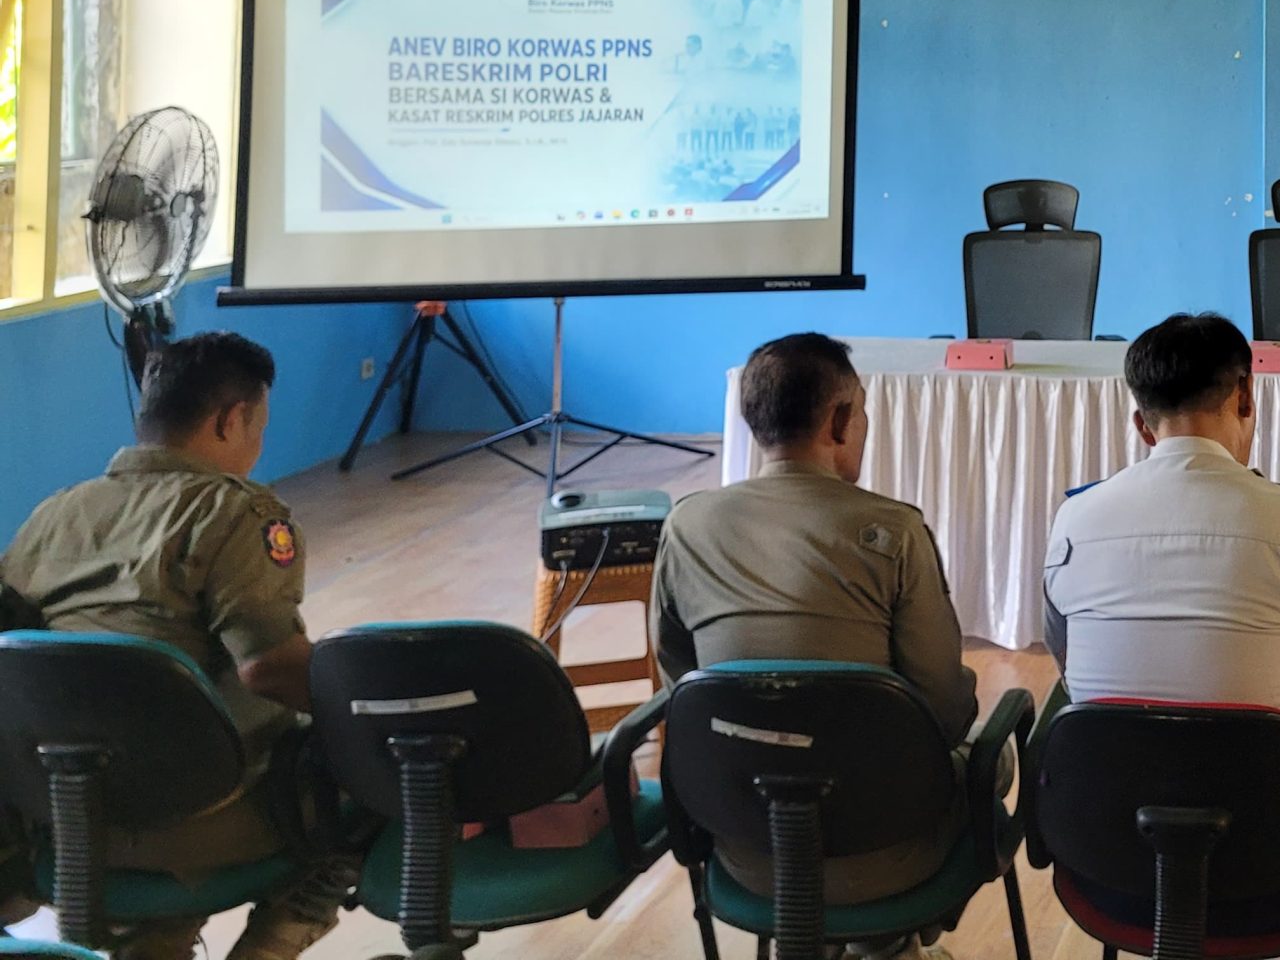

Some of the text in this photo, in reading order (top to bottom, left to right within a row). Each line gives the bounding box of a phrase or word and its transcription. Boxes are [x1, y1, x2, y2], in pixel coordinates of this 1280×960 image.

[388, 37, 652, 58] ANEV BIRO KORWAS PPNS
[388, 62, 608, 82] BARESKRIM POLRI
[388, 87, 612, 104] BERSAMA SI KORWAS &
[388, 108, 644, 123] KASAT RESKRIM POLRES JAJARAN
